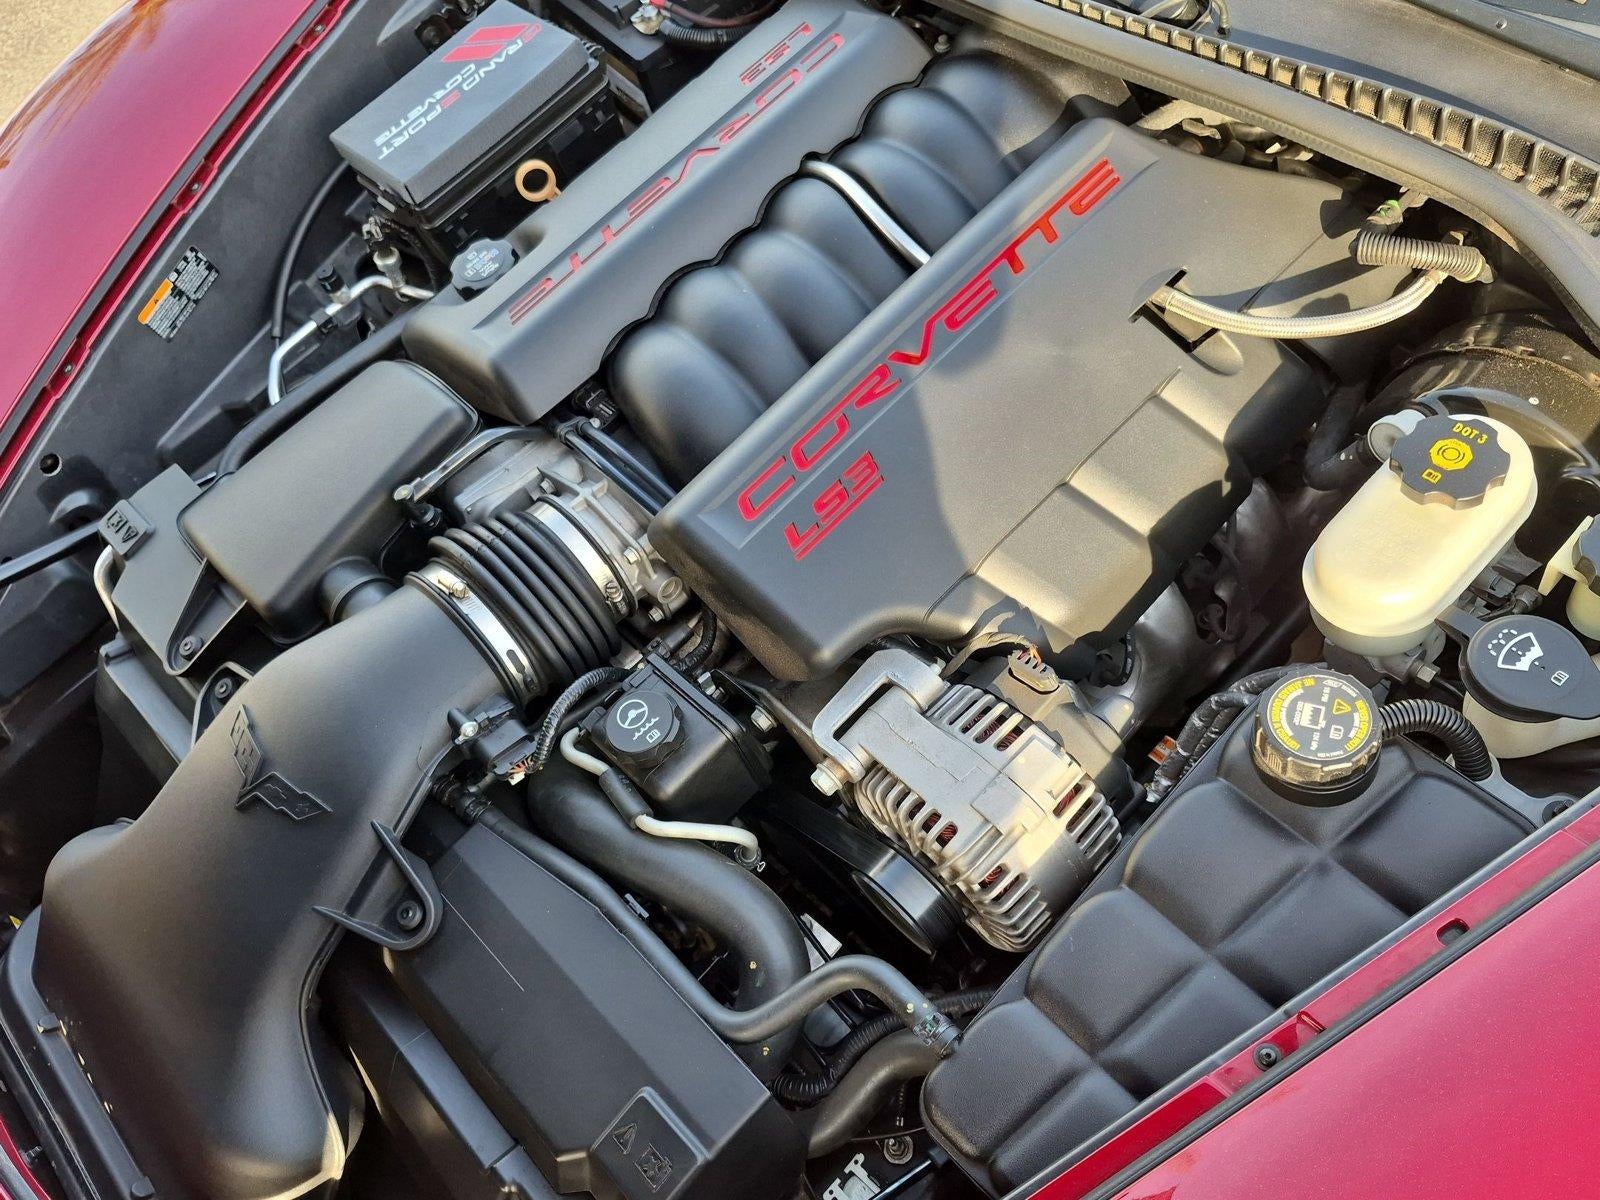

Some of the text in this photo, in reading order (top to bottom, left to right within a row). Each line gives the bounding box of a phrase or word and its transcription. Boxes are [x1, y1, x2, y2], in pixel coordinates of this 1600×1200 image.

[374, 63, 476, 147] CORVETTE
[378, 23, 542, 160] GRAND SPORT
[739, 21, 813, 85] LS3
[508, 32, 846, 326] CORVETTE
[736, 156, 1121, 522] CORVETTE
[1452, 422, 1488, 445] DOT 3
[784, 450, 885, 560] LS3
